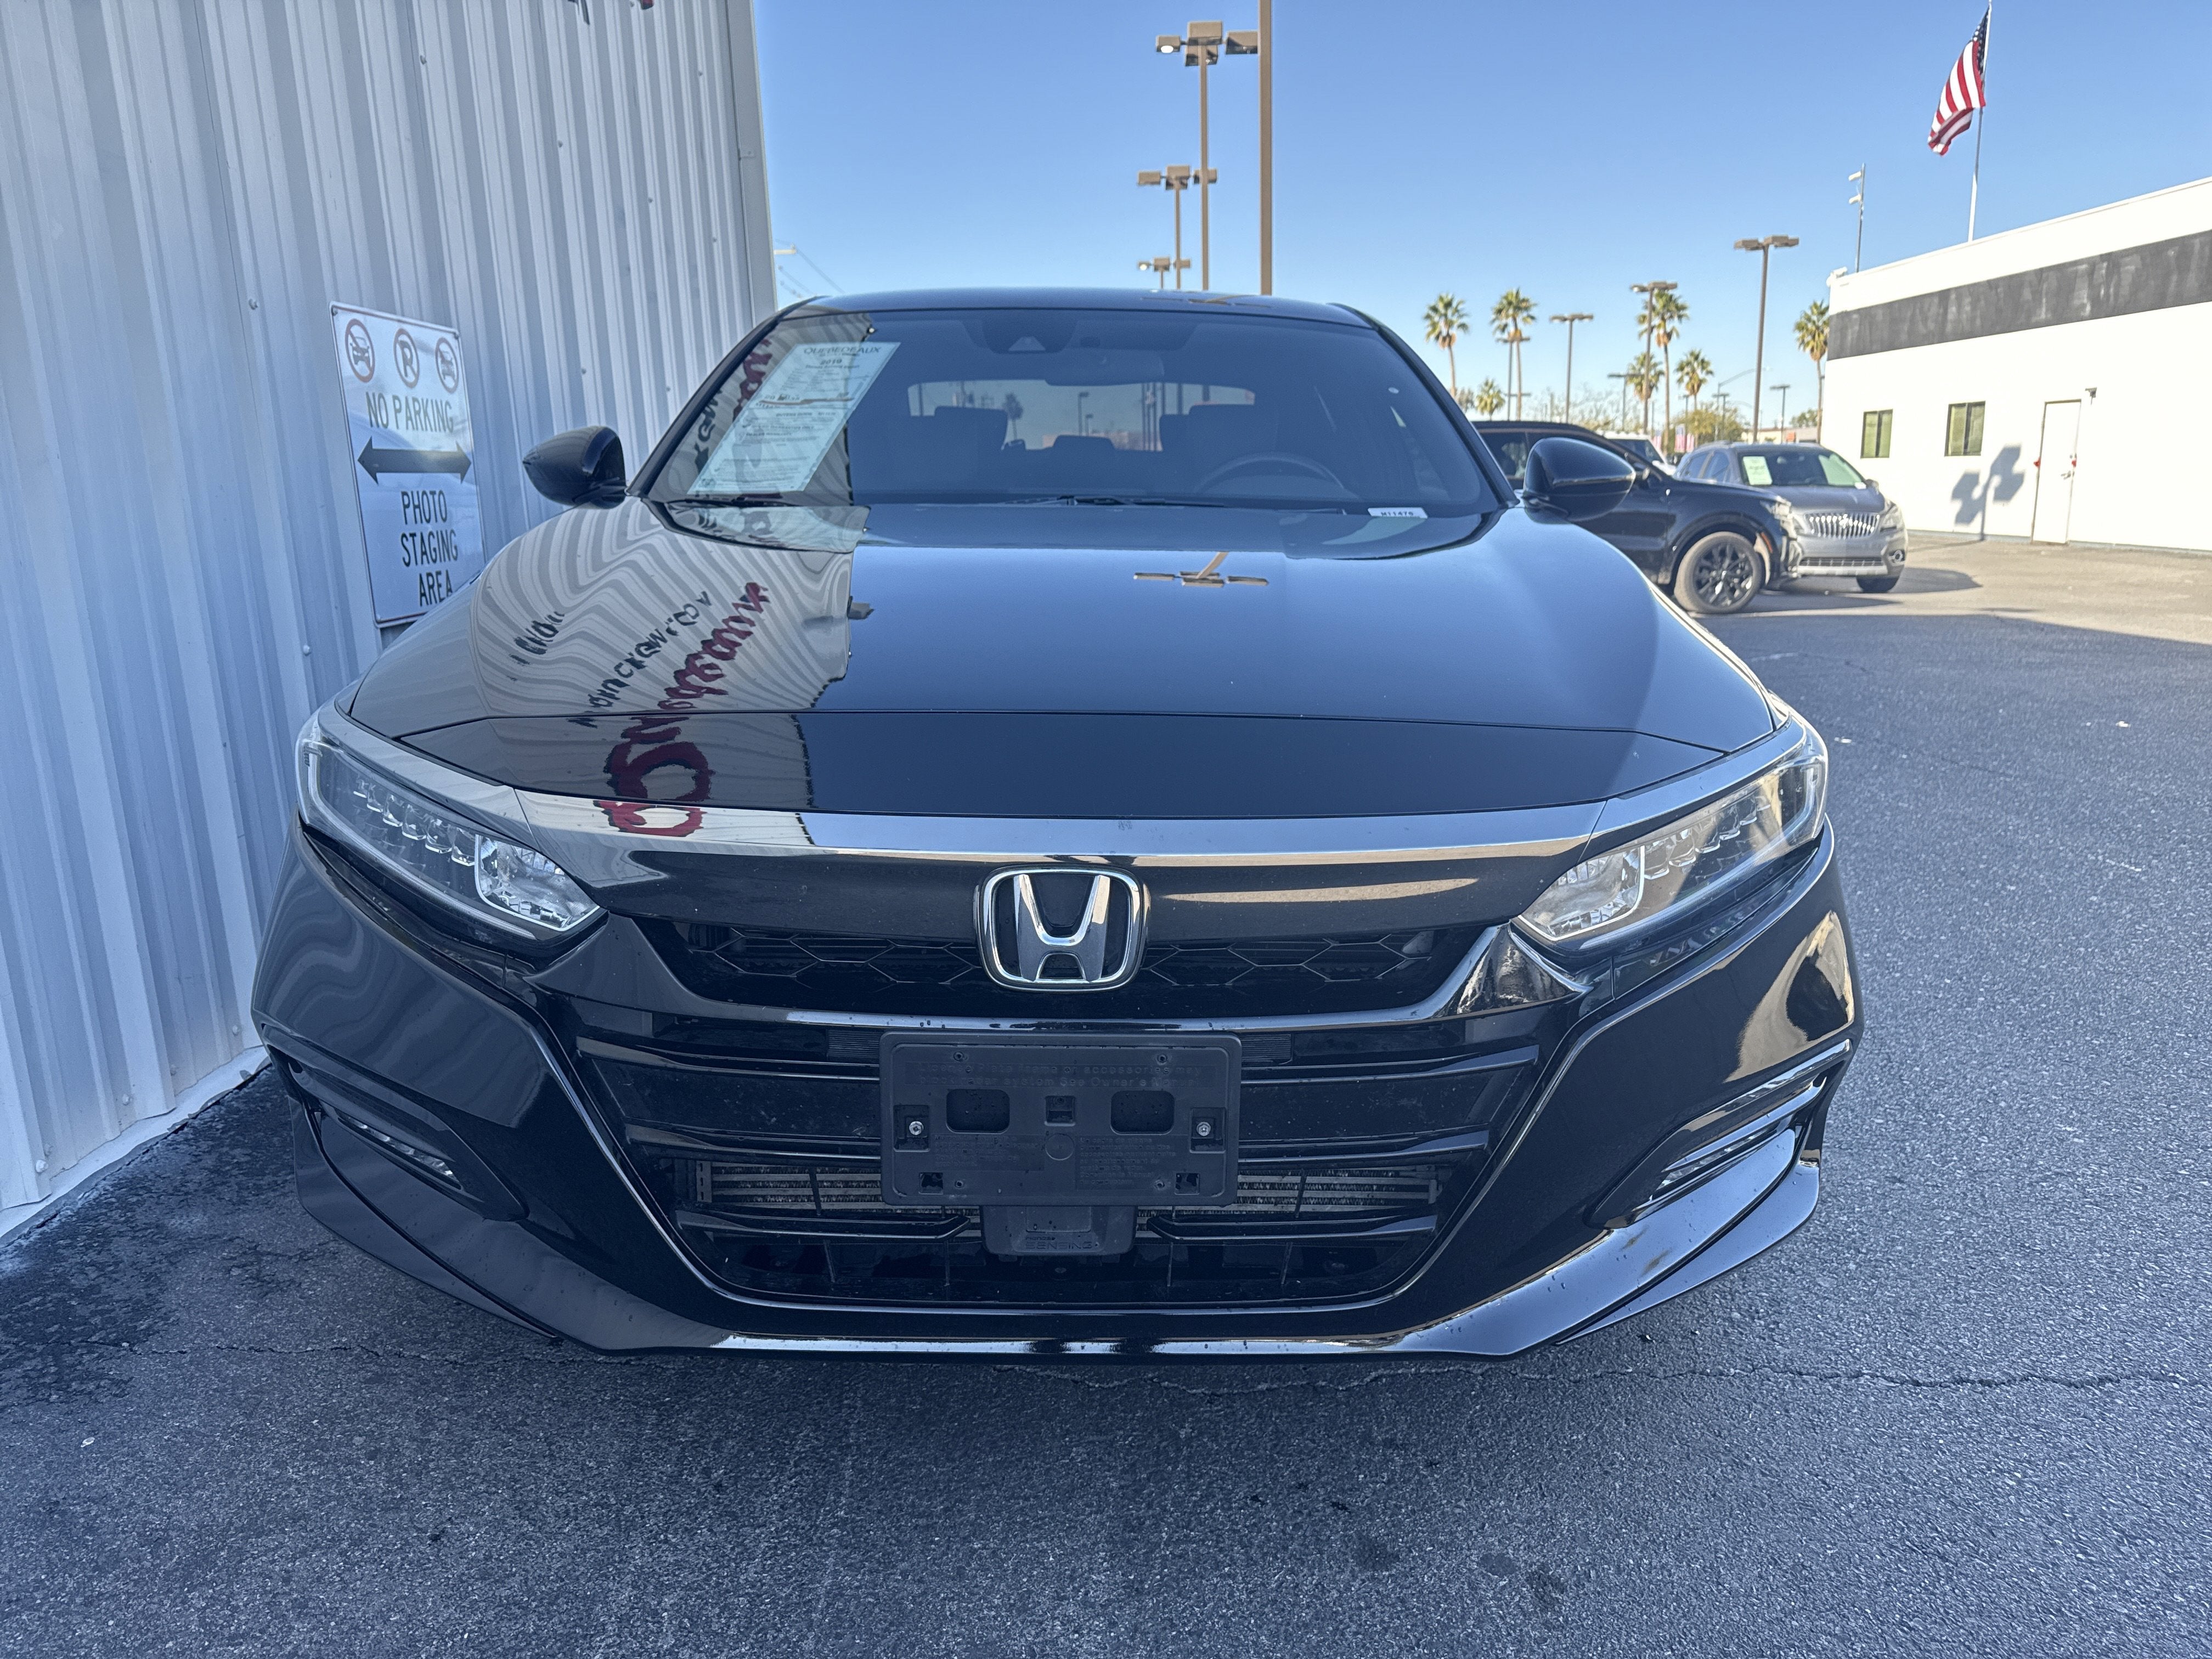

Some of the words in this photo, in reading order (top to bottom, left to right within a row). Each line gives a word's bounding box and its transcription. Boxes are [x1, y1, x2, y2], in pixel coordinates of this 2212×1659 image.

[365, 391, 389, 428] NO
[393, 395, 454, 433] PARKING
[401, 490, 447, 524] PHOTO
[401, 529, 458, 567] STAGING
[419, 569, 453, 607] AREA
